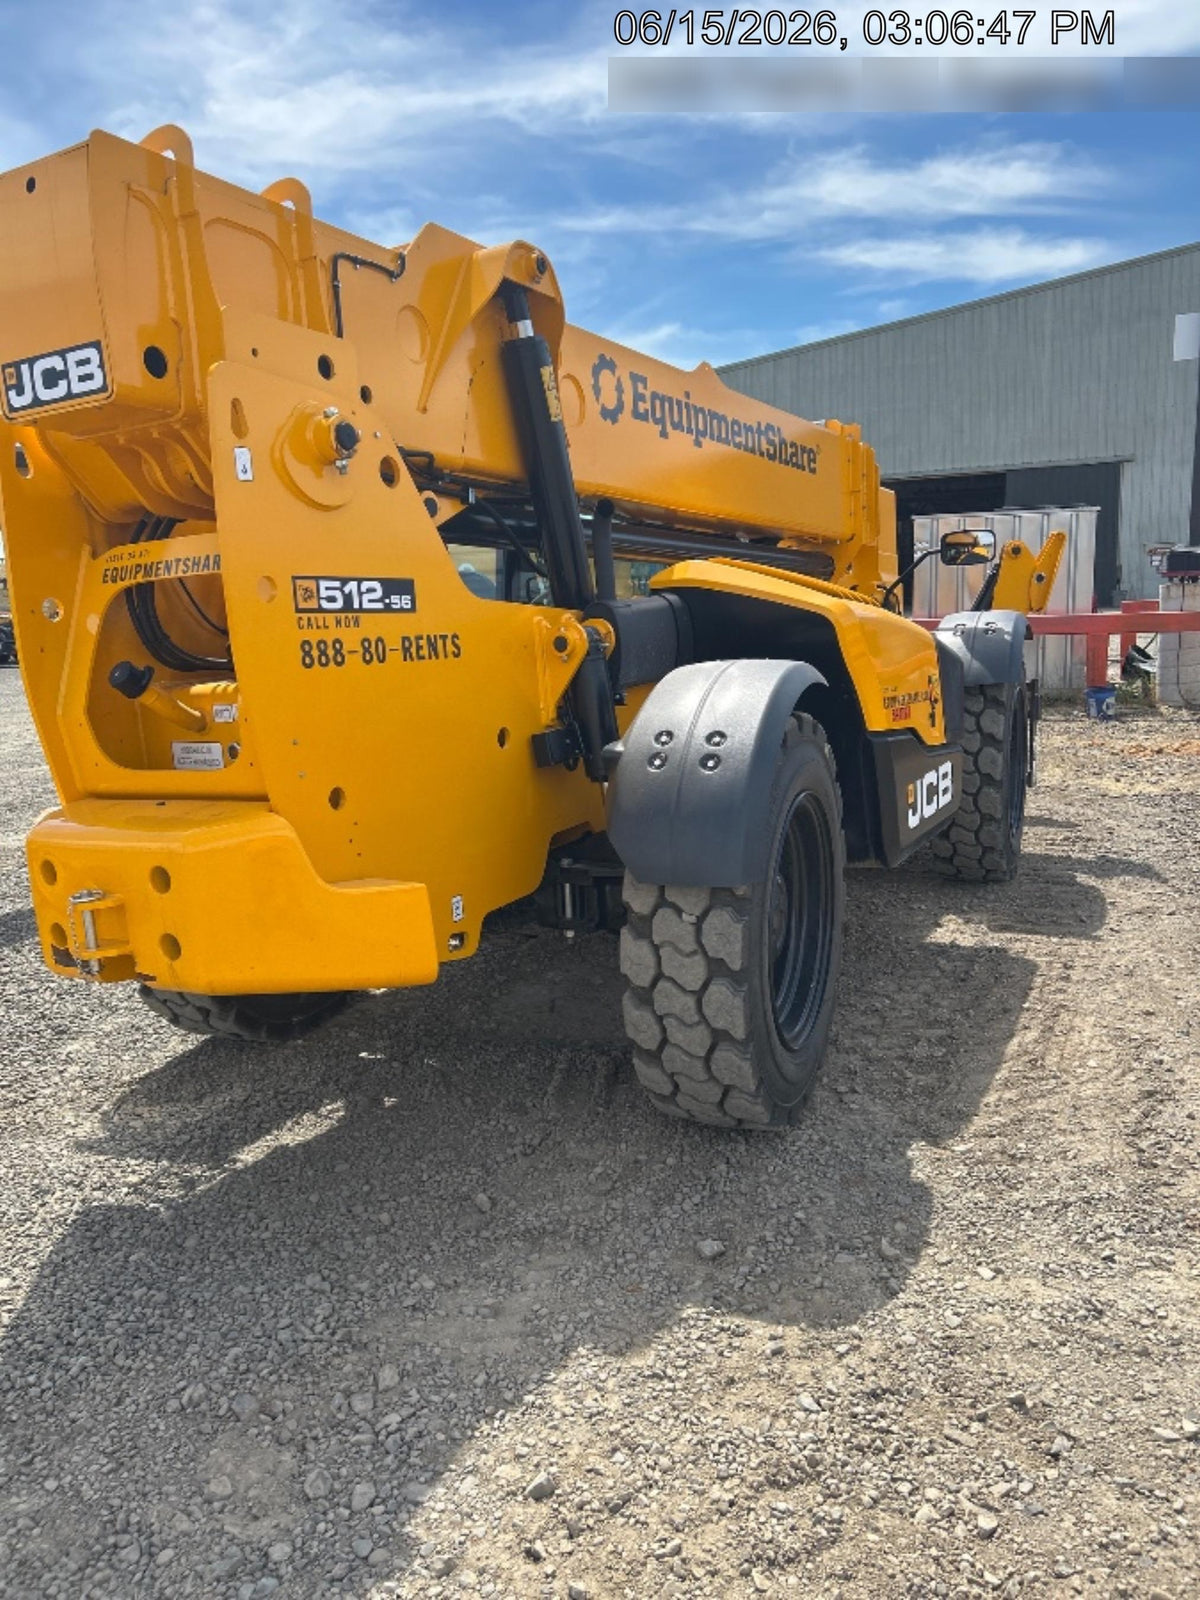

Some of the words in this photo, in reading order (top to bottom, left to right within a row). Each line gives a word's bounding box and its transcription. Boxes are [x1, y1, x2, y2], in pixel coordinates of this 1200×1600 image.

[8, 347, 104, 408] JCB
[629, 371, 818, 475] EquipmentShare
[102, 553, 221, 584] EQUIPMENTSHAR
[297, 616, 329, 630] CALL
[335, 614, 361, 628] NOW
[301, 633, 461, 668] 888-80-RENTS
[907, 760, 953, 829] JCB
